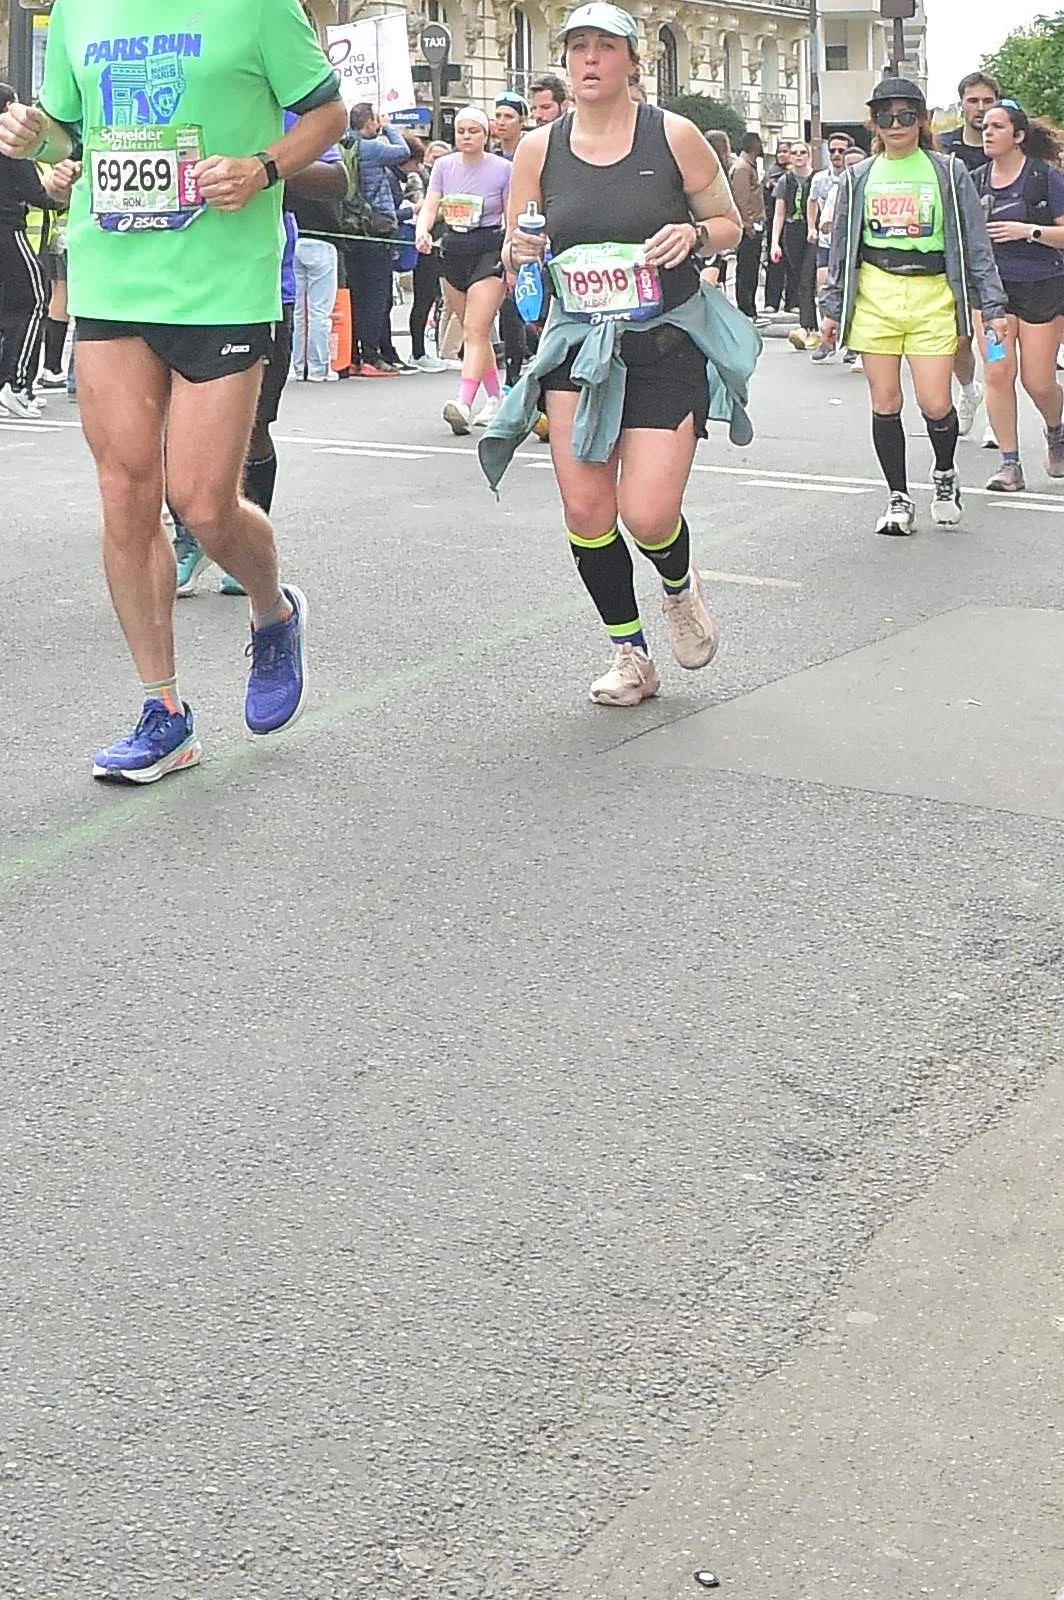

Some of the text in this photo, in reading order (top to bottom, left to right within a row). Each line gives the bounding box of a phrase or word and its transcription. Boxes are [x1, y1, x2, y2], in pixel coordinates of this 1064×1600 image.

[84, 33, 201, 66] PARIS RUN
[423, 37, 446, 48] TAXI
[355, 75, 377, 85] LES
[99, 127, 164, 143] Schneider
[97, 158, 172, 192] 69269
[871, 198, 916, 216] 58274
[134, 216, 168, 228] asics
[562, 267, 629, 296] 78918
